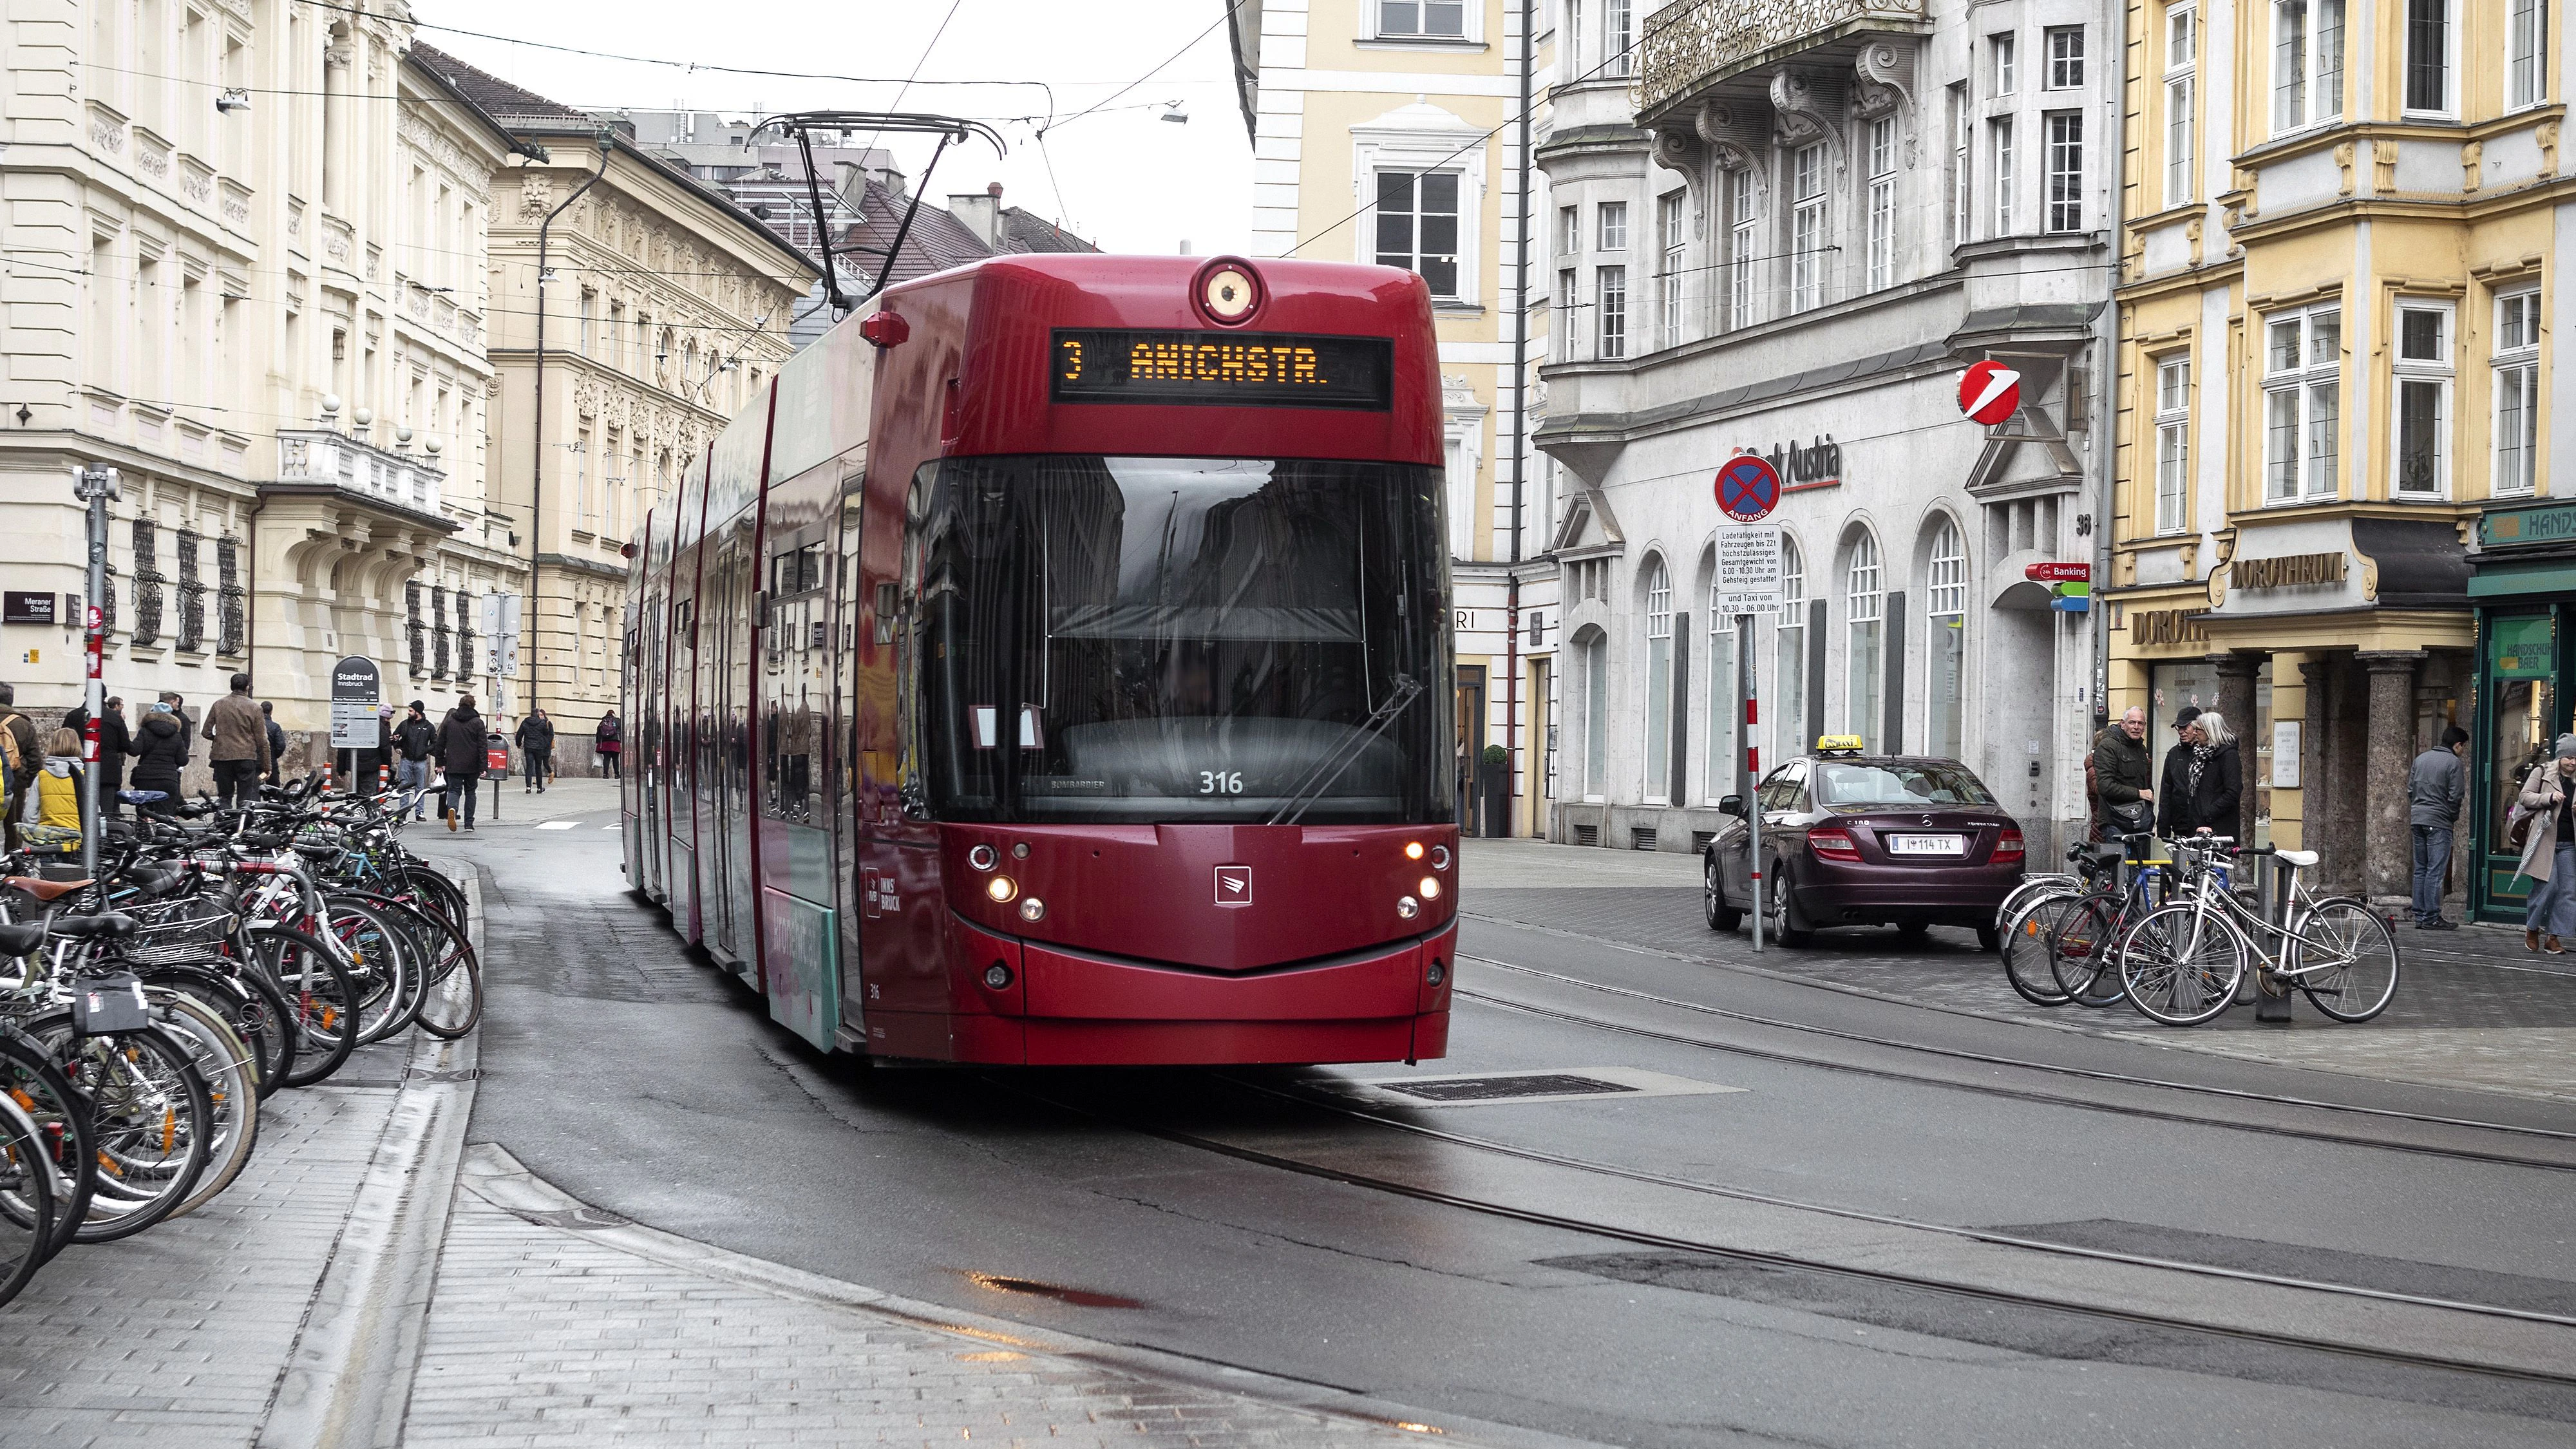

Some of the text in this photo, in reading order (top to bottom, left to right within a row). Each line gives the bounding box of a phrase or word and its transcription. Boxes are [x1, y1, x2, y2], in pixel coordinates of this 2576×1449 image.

[1064, 341, 1327, 383] 3 ANICHSTR.
[1786, 433, 1839, 482] Austria
[1727, 508, 1768, 522] ANFANG
[2076, 513, 2092, 536] 36
[1722, 531, 1763, 540] Ladetätigkeit
[1721, 540, 1754, 549] Fahrzeugen
[1721, 558, 1765, 567] Gesamtgewicht
[2054, 567, 2087, 578] Banking
[2230, 552, 2344, 589] DOROTHEUM
[1750, 576, 1777, 584] gestattet
[1456, 611, 1474, 628] RI
[2518, 656, 2539, 669] BAER
[1051, 781, 1104, 789] BOMBARDIER
[1200, 771, 1243, 793] 316
[1919, 839, 1934, 849] 114
[1938, 839, 1951, 850] TX
[881, 895, 900, 912] BRUCK
[870, 983, 879, 999] 316
